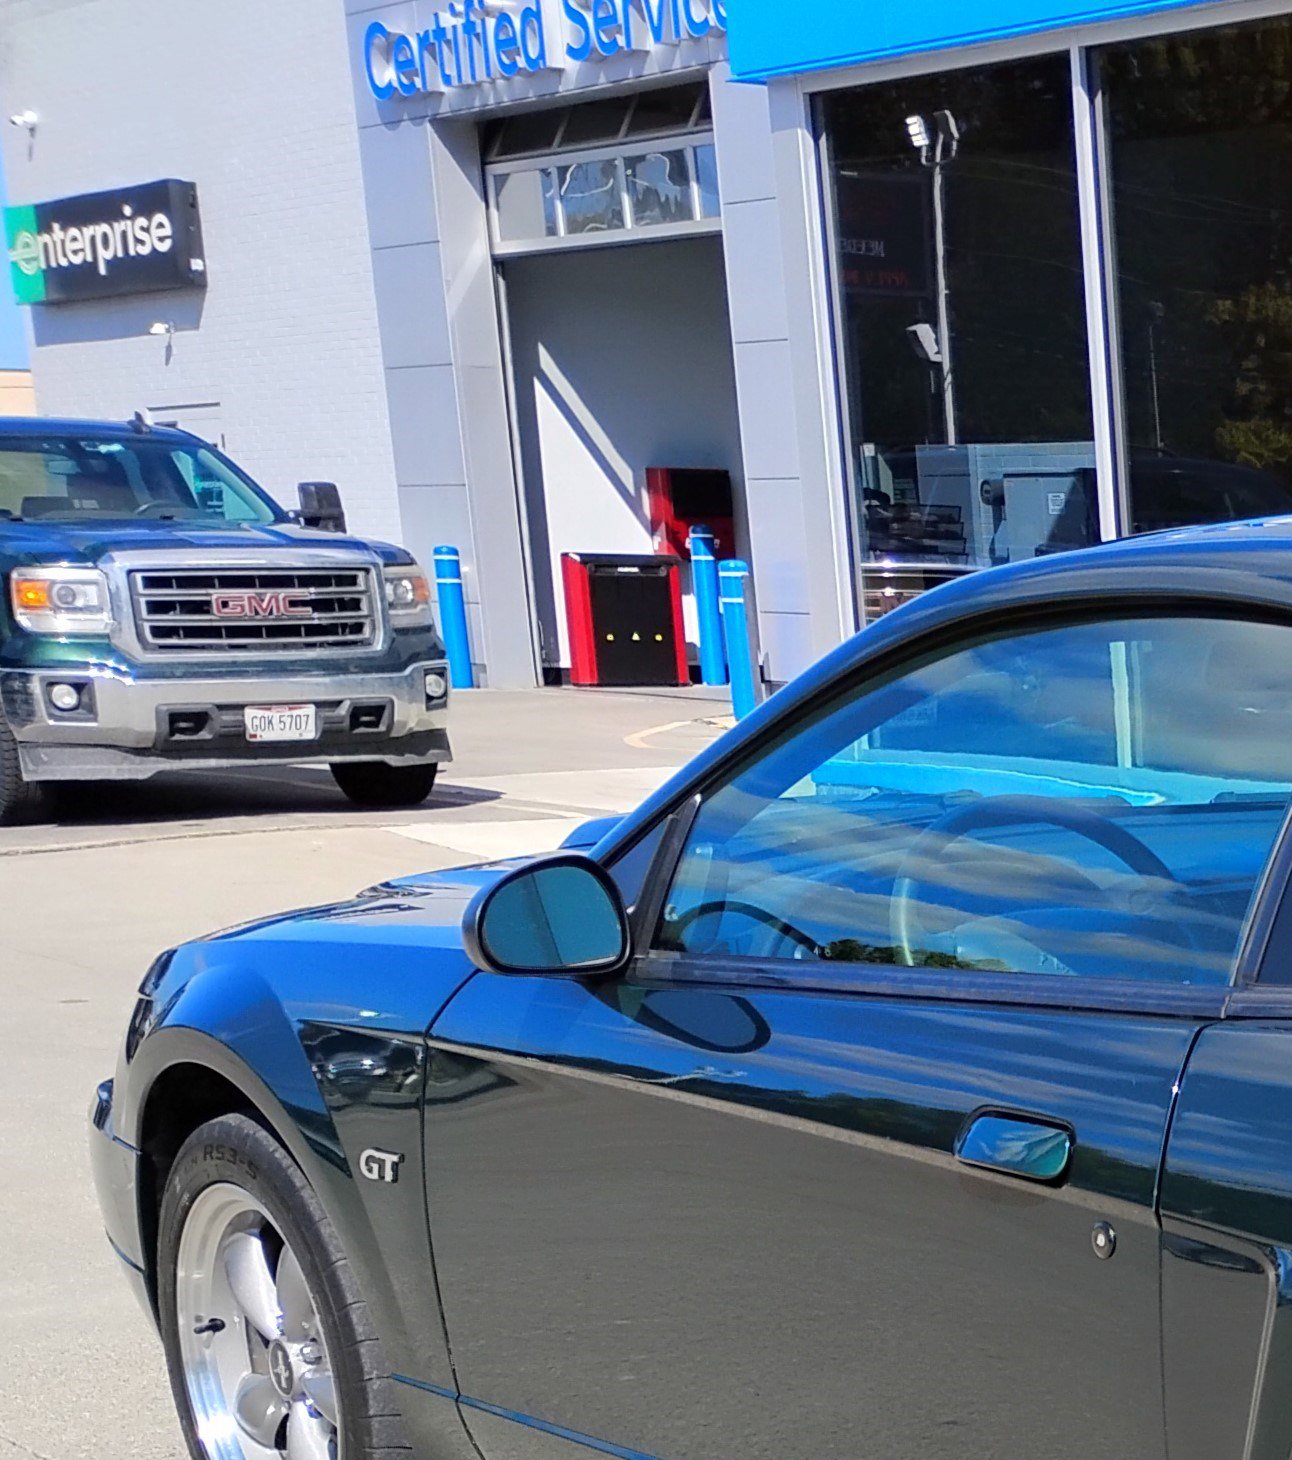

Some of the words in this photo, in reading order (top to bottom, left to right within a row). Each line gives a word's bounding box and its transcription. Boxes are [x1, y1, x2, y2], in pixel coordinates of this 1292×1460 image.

[364, 0, 549, 100] Certified
[9, 204, 173, 275] enterprise
[211, 592, 313, 617] GMC
[278, 713, 310, 731] 5707
[360, 1147, 402, 1183] GT
